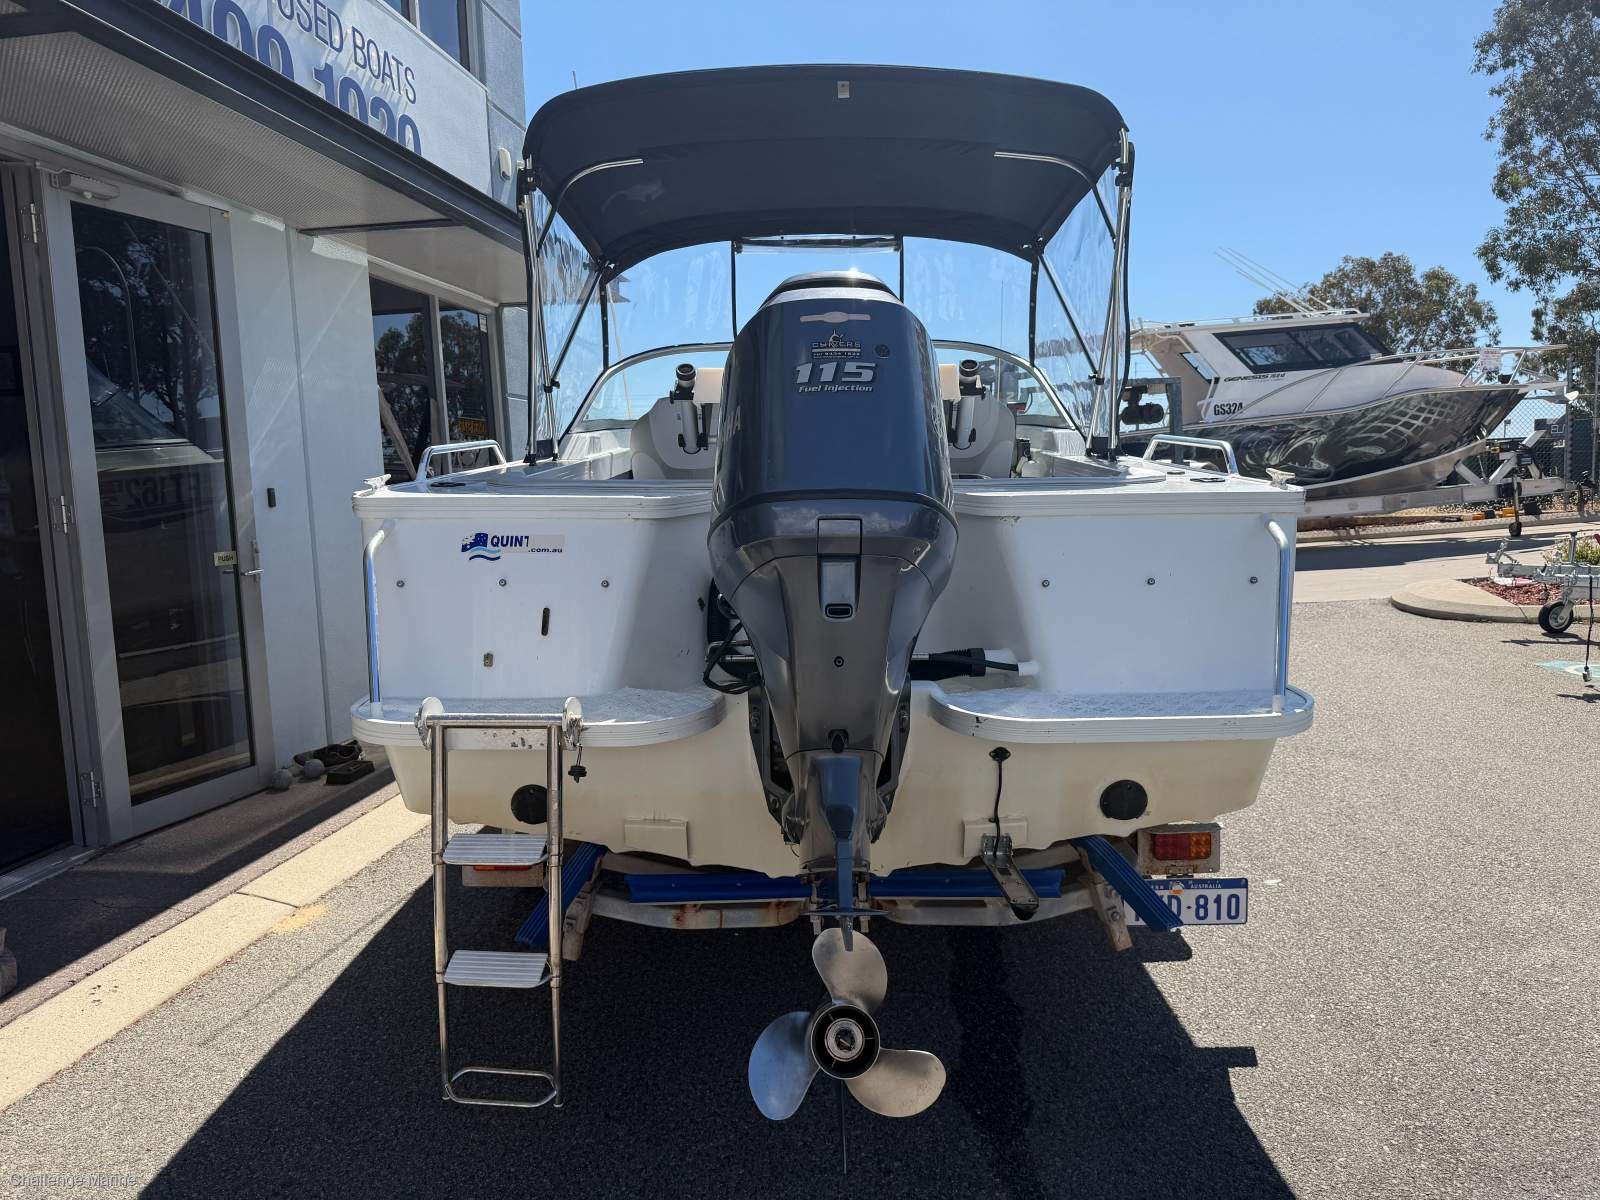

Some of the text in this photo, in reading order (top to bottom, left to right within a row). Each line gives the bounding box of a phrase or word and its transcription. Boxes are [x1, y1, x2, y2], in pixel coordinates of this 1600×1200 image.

[352, 26, 417, 105] BOATS
[795, 362, 876, 384] 115
[799, 384, 872, 393] Fuel Injection
[217, 554, 234, 562] PUSH
